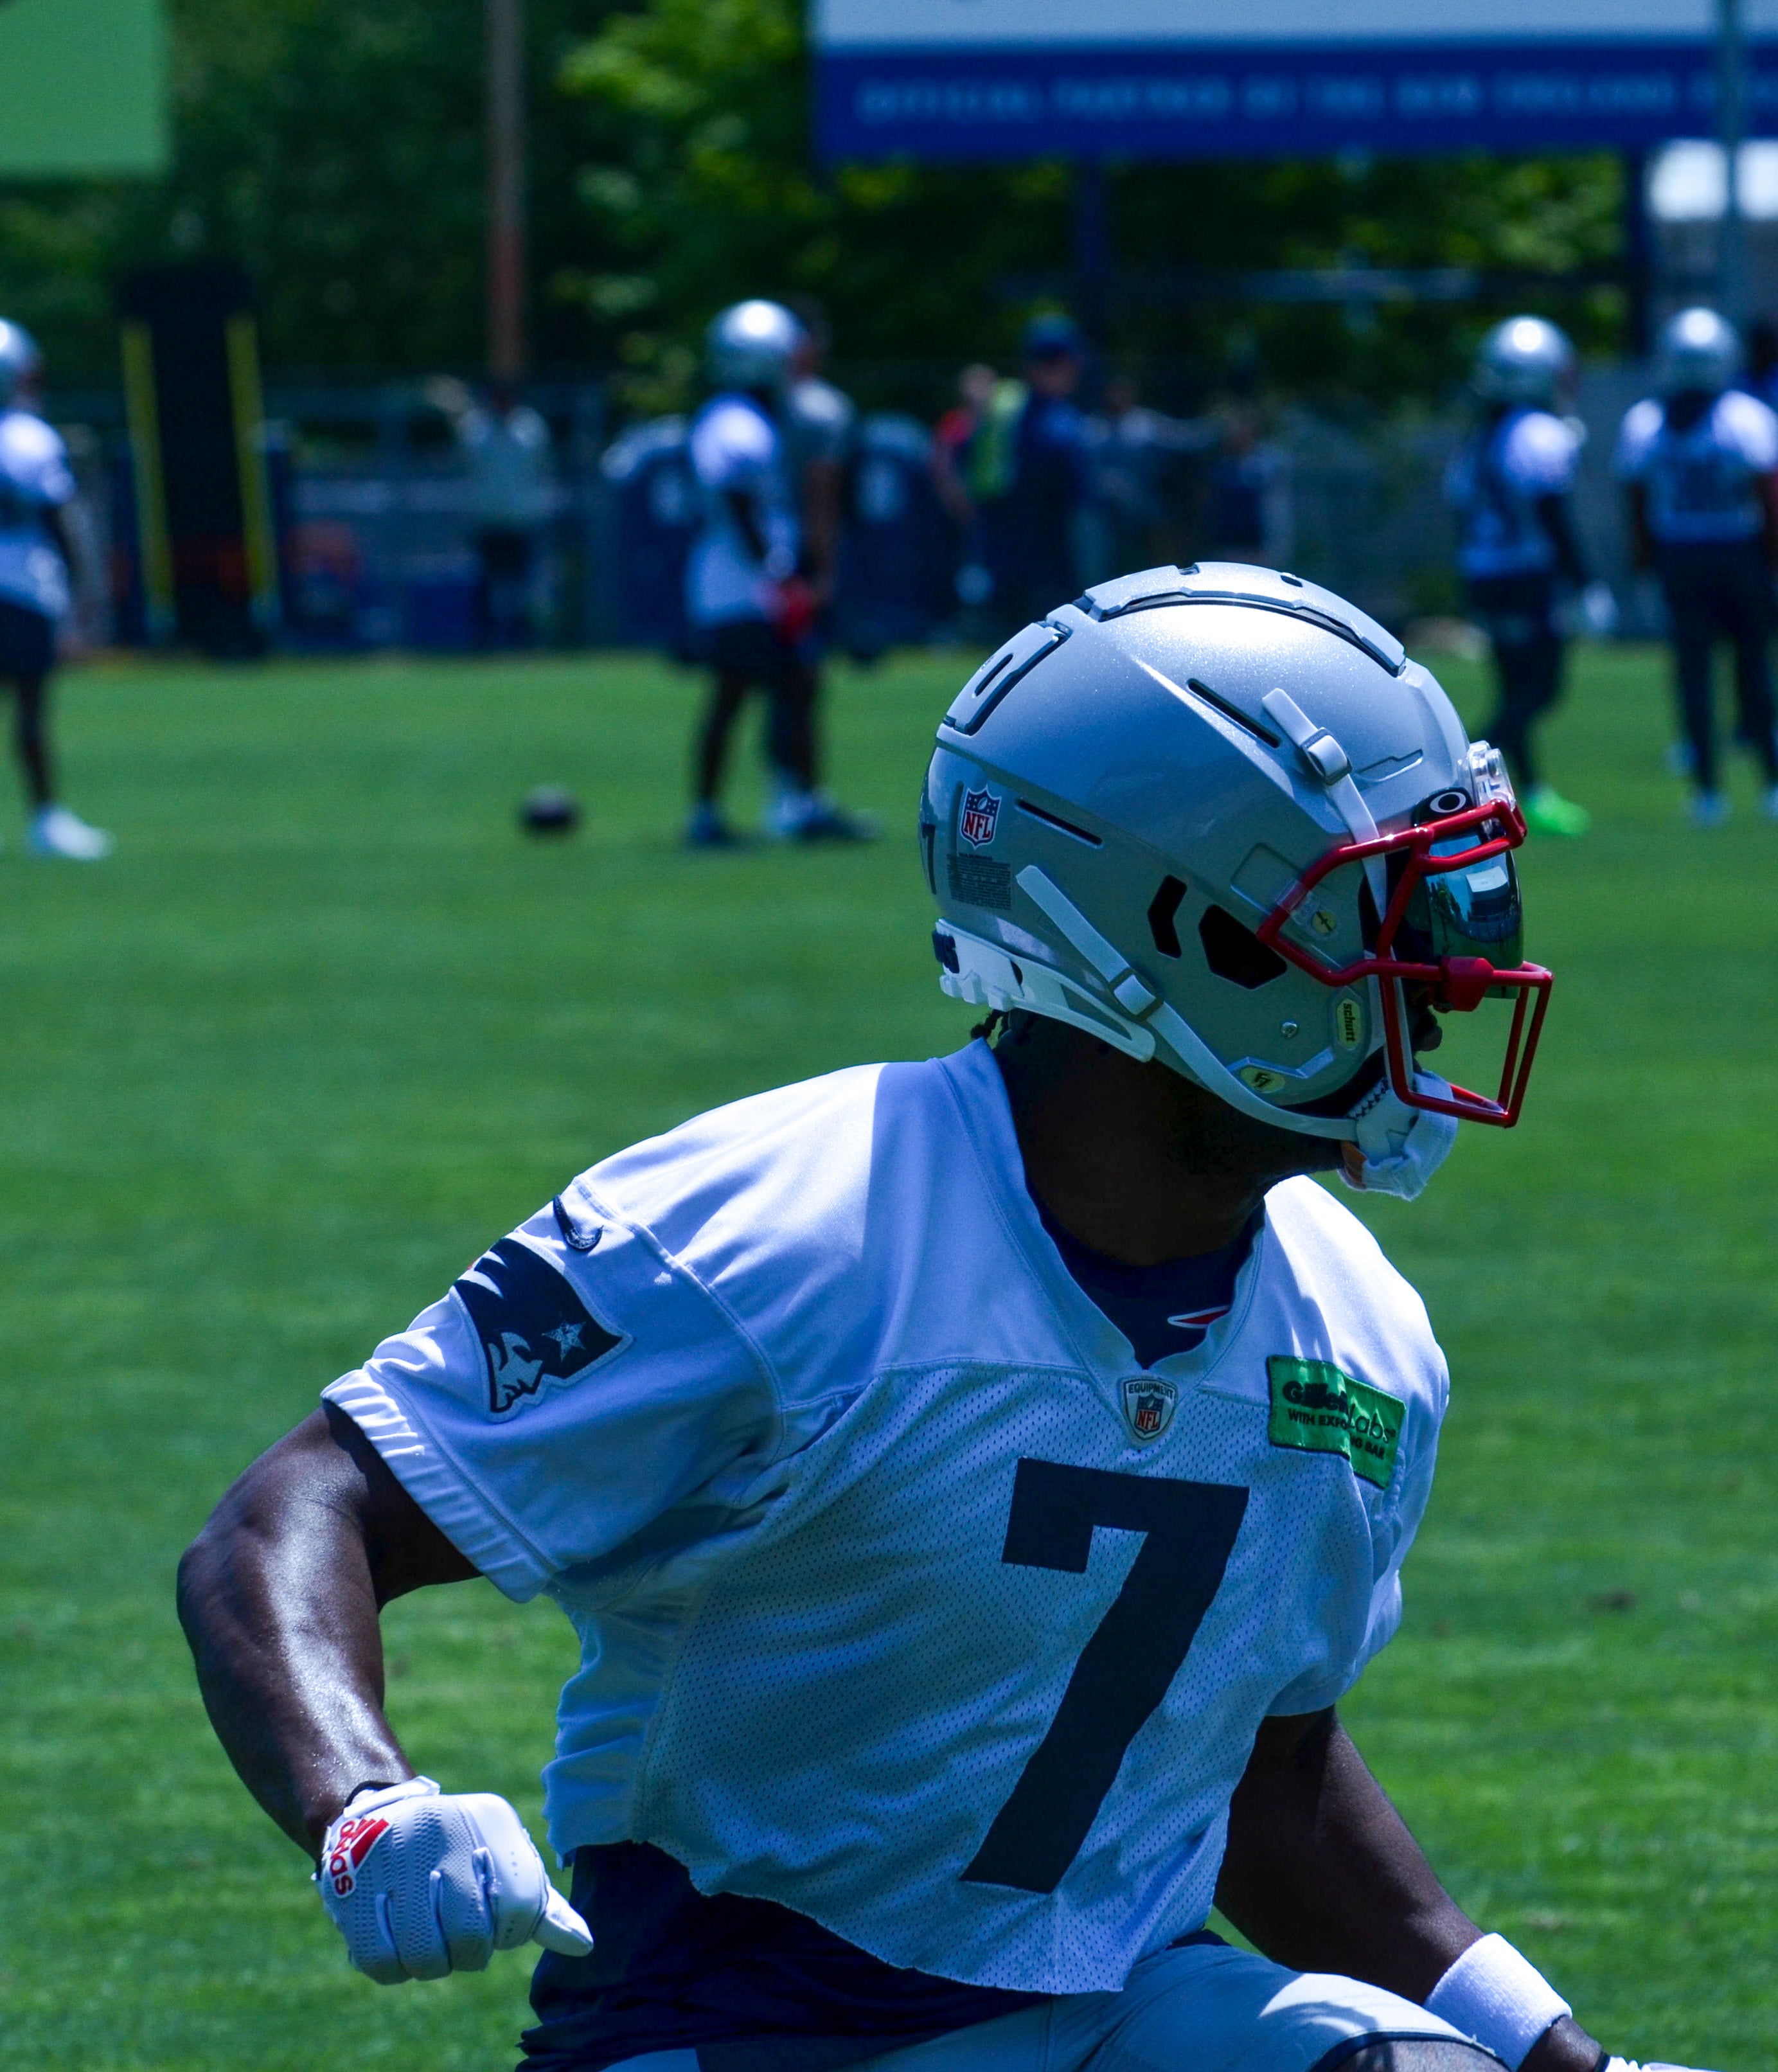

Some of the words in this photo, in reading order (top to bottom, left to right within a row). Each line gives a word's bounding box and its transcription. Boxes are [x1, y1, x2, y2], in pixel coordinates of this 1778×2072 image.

[964, 811, 991, 840] NFL
[1128, 1382, 1174, 1399] EQUIPMENT
[1137, 1409, 1159, 1430] NFL
[1288, 1408, 1315, 1425] WITH
[959, 1456, 1250, 1894] 7
[330, 1820, 354, 1896] adas
